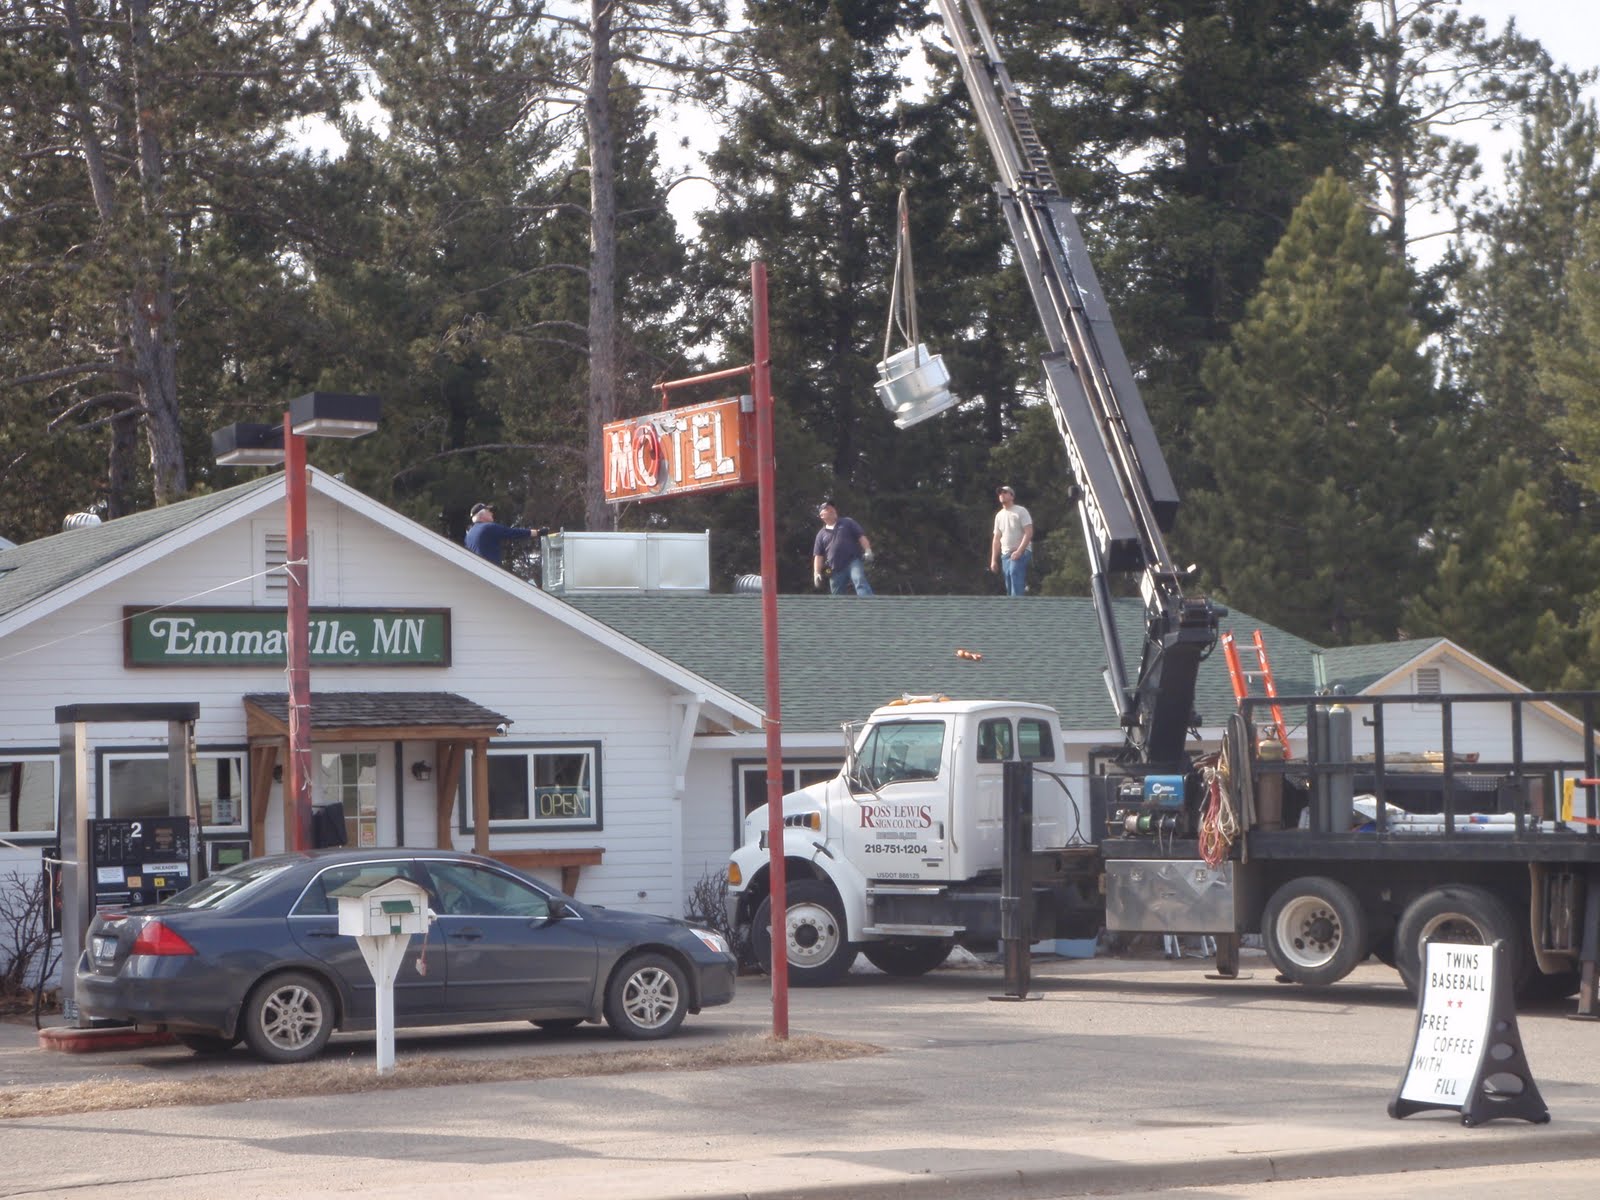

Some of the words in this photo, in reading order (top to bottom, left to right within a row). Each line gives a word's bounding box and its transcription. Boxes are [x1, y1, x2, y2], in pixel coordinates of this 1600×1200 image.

[605, 411, 734, 493] MOTEL
[371, 618, 424, 654] MN
[540, 793, 586, 816] OPEN
[859, 805, 891, 828] ROSS
[894, 805, 932, 828] LEWIS
[130, 822, 142, 838] 2
[864, 844, 928, 854] 218-751-1204
[1447, 953, 1478, 969] TWINS
[1432, 973, 1484, 991] BASEBALL
[1420, 1014, 1449, 1031] FREE
[1434, 1037, 1474, 1054] COFFEE
[1415, 1056, 1443, 1072] WITH
[1434, 1078, 1457, 1096] FILL
